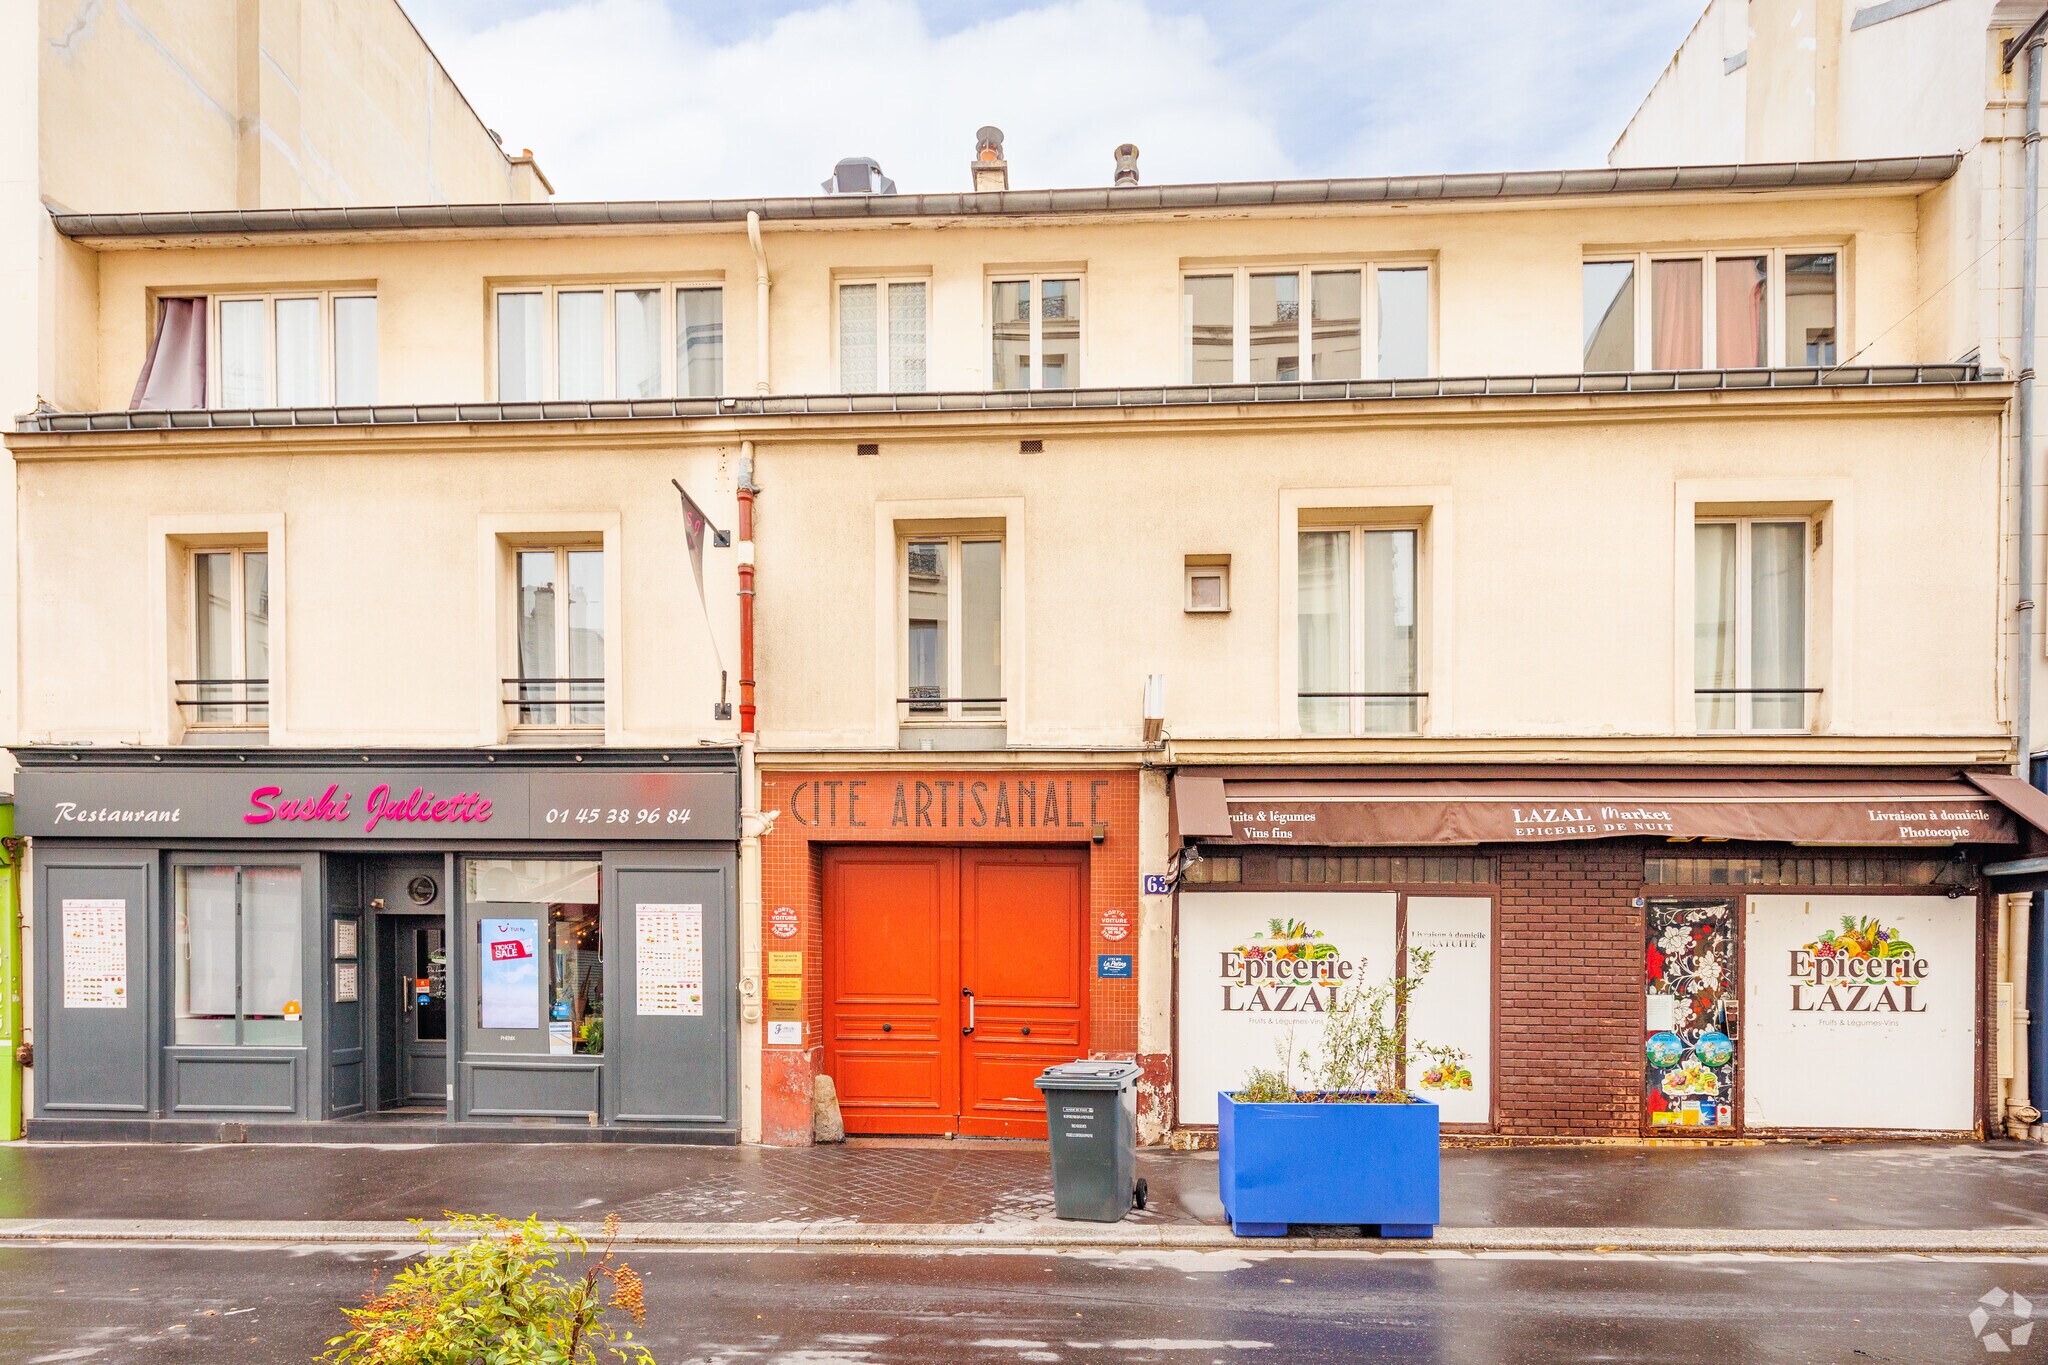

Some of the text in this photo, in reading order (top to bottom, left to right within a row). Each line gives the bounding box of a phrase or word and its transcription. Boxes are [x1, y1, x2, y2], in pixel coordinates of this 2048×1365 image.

[243, 783, 494, 833] Sushi Juliette
[790, 780, 1109, 828] CITE ARTISANALE
[54, 802, 181, 824] Restaurant
[545, 807, 691, 825] 01 45 38 96 84
[1228, 810, 1316, 825] ruits & légumes
[1512, 806, 1672, 823] LAZAL Market
[1867, 809, 1990, 821] Livraison à domicile
[1243, 827, 1293, 839] Vins fins
[1515, 822, 1674, 836] EPICERIE DE NUIT
[1899, 826, 1970, 839] Photocopie
[1147, 876, 1169, 893] 63
[1454, 931, 1487, 940] domicile
[495, 943, 517, 951] TICKET
[495, 949, 518, 958] SALE
[1219, 951, 1354, 986] Epicerie
[1787, 950, 1930, 986] Epicerie
[1220, 985, 1350, 1013] LAZAL
[1789, 984, 1928, 1013] LAZAL
[1248, 1017, 1267, 1025] Fruits
[1268, 1017, 1274, 1025] &
[1818, 1019, 1838, 1027] Fruits
[1839, 1019, 1846, 1027] &
